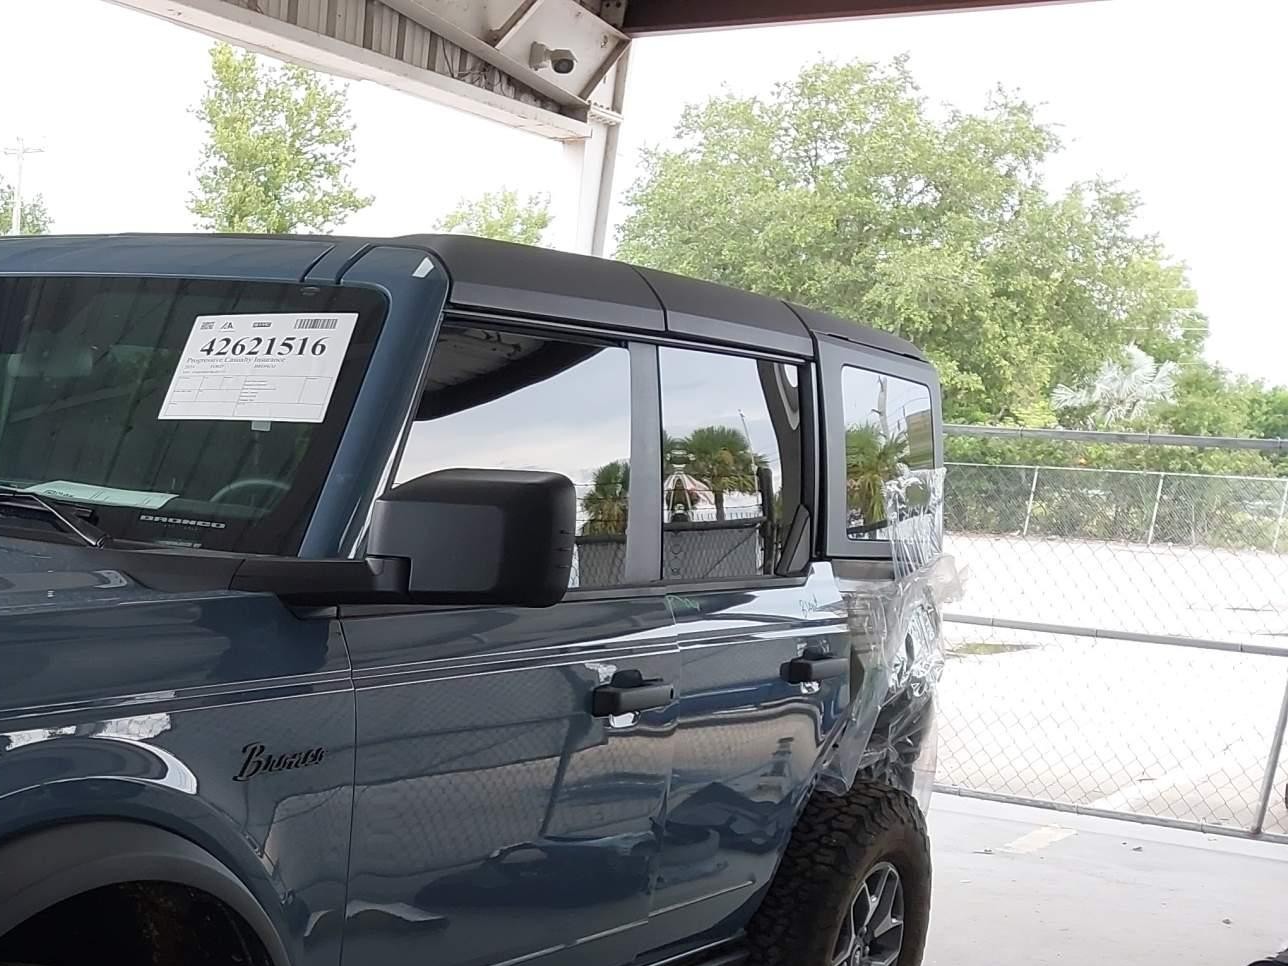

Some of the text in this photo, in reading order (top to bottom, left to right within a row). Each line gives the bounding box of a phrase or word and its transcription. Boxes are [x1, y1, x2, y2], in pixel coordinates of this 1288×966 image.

[200, 336, 329, 356] 42621516
[140, 514, 226, 529] BRONCO
[232, 741, 326, 781] Bronco
